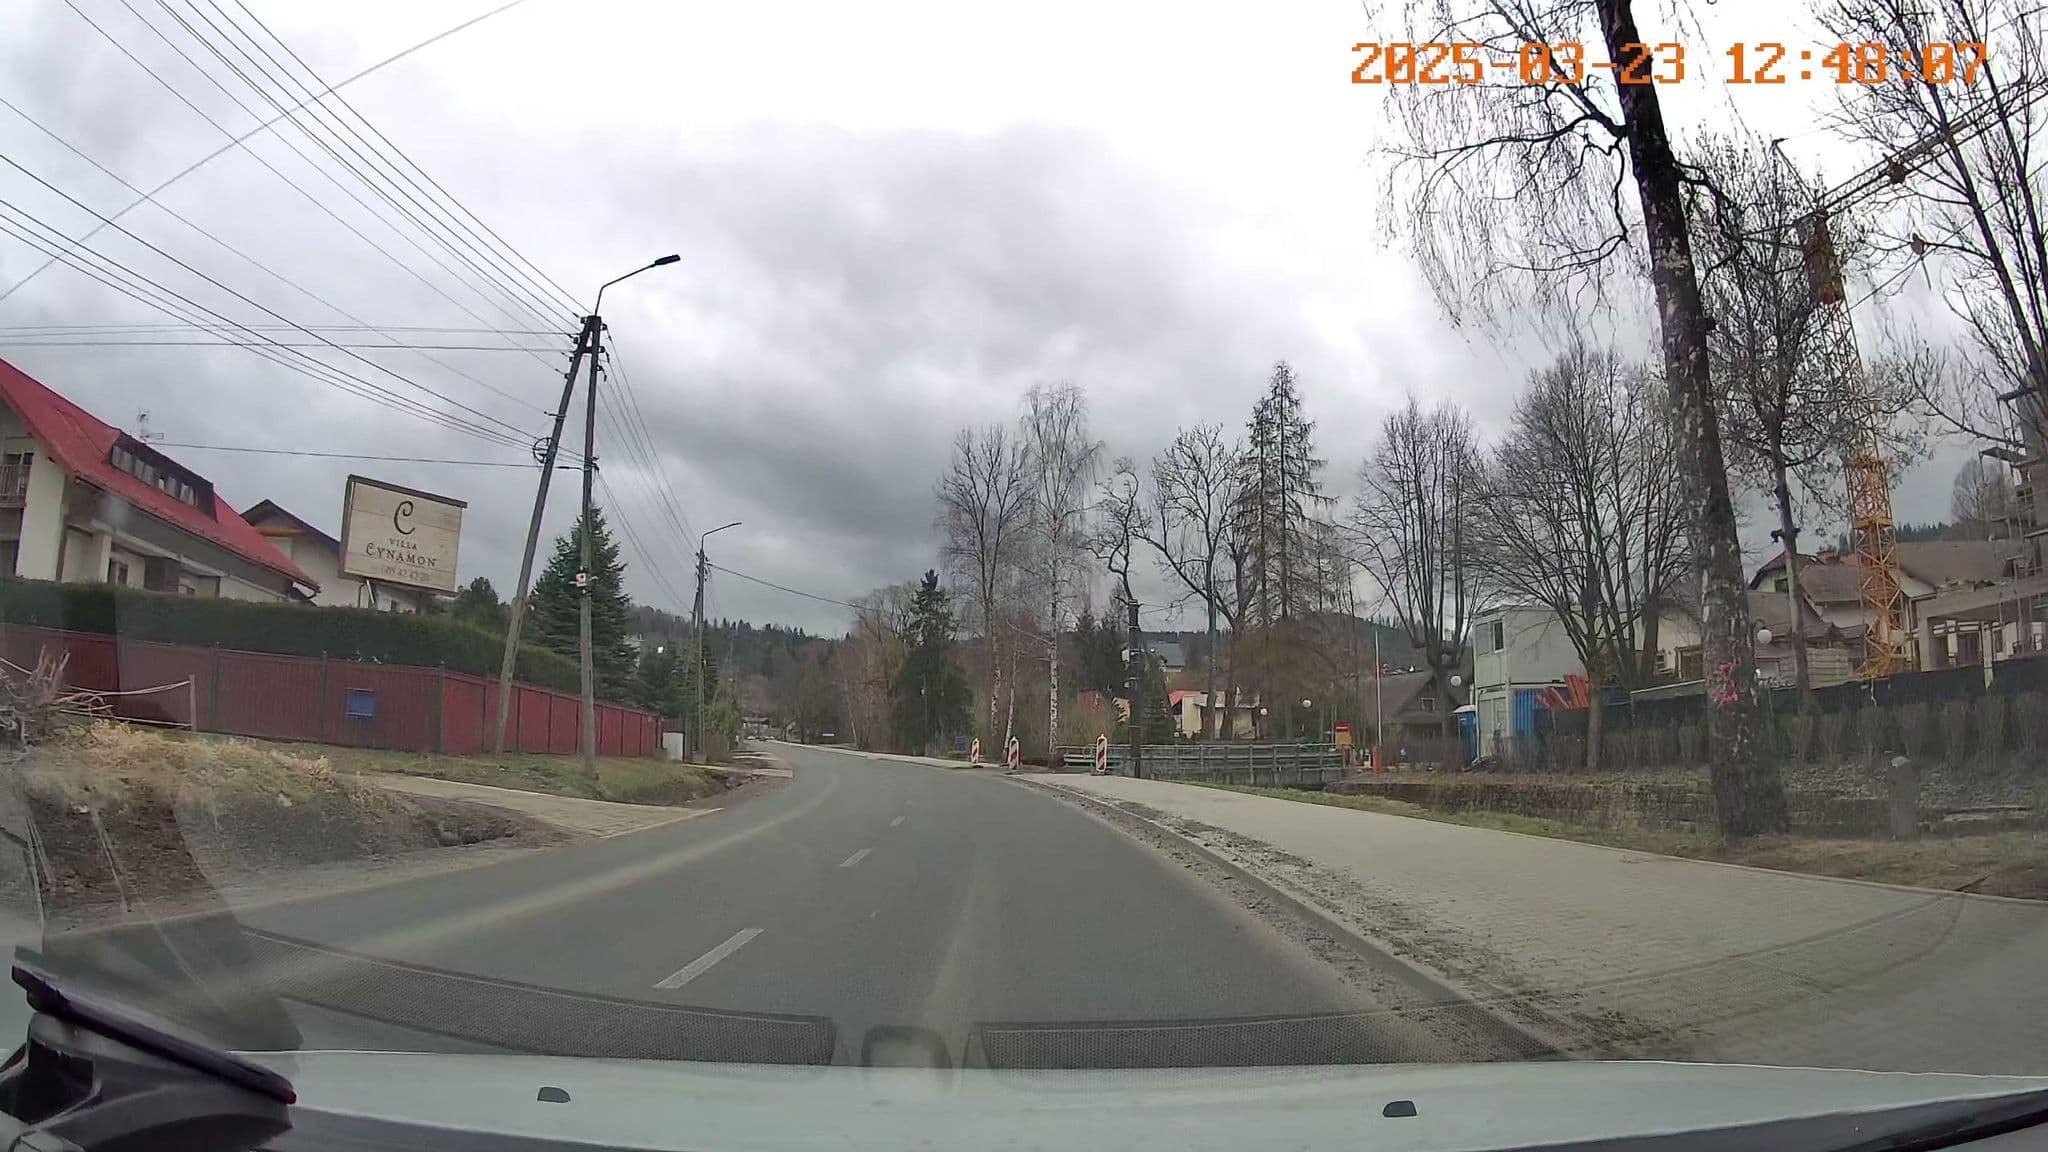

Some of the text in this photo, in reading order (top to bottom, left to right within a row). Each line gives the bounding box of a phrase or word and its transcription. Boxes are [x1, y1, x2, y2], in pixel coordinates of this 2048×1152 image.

[394, 500, 416, 535] C
[366, 543, 437, 566] CYNAMON
[389, 538, 418, 550] VILLA
